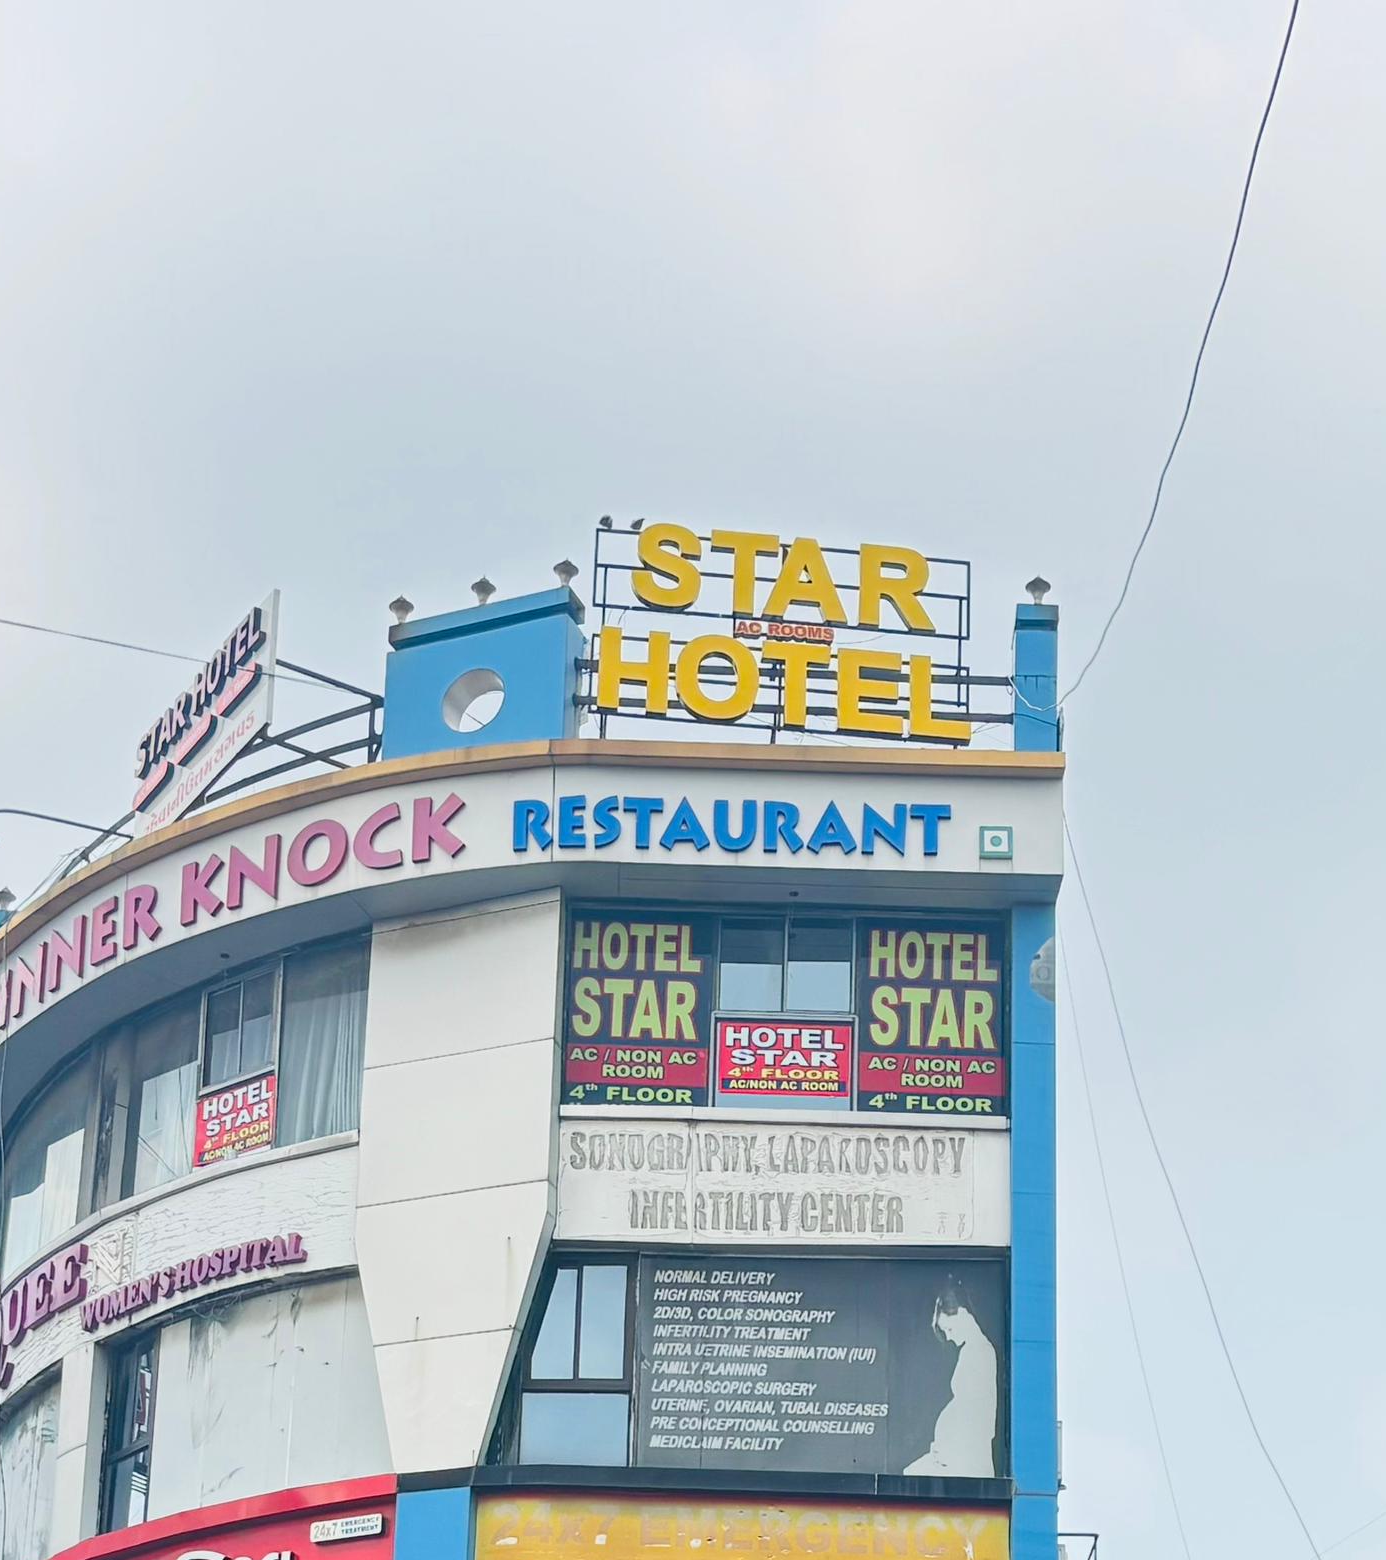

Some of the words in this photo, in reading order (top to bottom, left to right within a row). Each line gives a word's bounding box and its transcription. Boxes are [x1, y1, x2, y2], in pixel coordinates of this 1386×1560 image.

[631, 523, 936, 634] STAR
[735, 620, 761, 638] AC
[767, 622, 835, 645] ROOMS
[135, 692, 193, 780] STAR
[192, 607, 267, 717] HOTEL
[597, 626, 971, 745] HOTEL
[512, 796, 952, 857] RESTAURANT
[180, 793, 466, 927] KNOCK
[573, 921, 702, 974] HOTEL
[869, 930, 998, 983] HOTEL
[572, 976, 698, 1041] STAR
[869, 985, 997, 1050] STAR
[725, 1026, 844, 1050] HOTEL
[569, 1047, 597, 1062] AC
[613, 1049, 662, 1064] NON
[667, 1051, 697, 1065] AC
[730, 1048, 837, 1069] STAR
[868, 1056, 898, 1072] AC
[913, 1058, 962, 1074] NON
[966, 1059, 997, 1075] AC
[601, 1064, 664, 1080] ROOM
[761, 1068, 839, 1081] FLOOR
[901, 1073, 963, 1090] ROOM
[569, 1083, 598, 1098] 4th
[606, 1086, 693, 1104] FLOOR
[800, 1080, 839, 1092] ROOM
[203, 1080, 273, 1120] HOTEL
[868, 1091, 898, 1109] 4th
[906, 1095, 992, 1113] FLOOR
[206, 1102, 269, 1137] STAR
[223, 1121, 270, 1145] FLOOR
[801, 1191, 904, 1234] CENTER
[80, 1265, 178, 1333] WOMEN'S
[174, 1232, 308, 1290] HOSPITAL
[654, 1269, 709, 1285] NORMAL
[710, 1271, 775, 1287] DELIVERY
[653, 1290, 688, 1303] HIGH
[689, 1290, 720, 1303] RISK
[721, 1290, 804, 1305] PREGNANCY
[697, 1308, 743, 1323] COLOR
[744, 1308, 835, 1325] SONOGRAPHY
[652, 1325, 731, 1340] INFERTILITY
[733, 1326, 812, 1342] TREATMENT
[652, 1343, 692, 1357] INTRA
[752, 1344, 847, 1361] INSEMINATION
[848, 1346, 877, 1364] (IUI)
[652, 1361, 700, 1376] FAMILY
[700, 1362, 767, 1377] PLANNING
[651, 1379, 753, 1395] LAPAROSCOPIC
[755, 1381, 817, 1397] SURGERY
[713, 1399, 777, 1416] OVARIAN,
[780, 1401, 823, 1416] TUBAL
[824, 1402, 889, 1417] DISEASES
[650, 1417, 678, 1430] PRE
[679, 1417, 781, 1433] CONCEPTIONAL
[782, 1419, 875, 1435] COUNSELLING
[650, 1435, 722, 1450] MEDICLAIM
[724, 1436, 784, 1451] FACILITY
[640, 1504, 987, 1558] EMERGENCY
